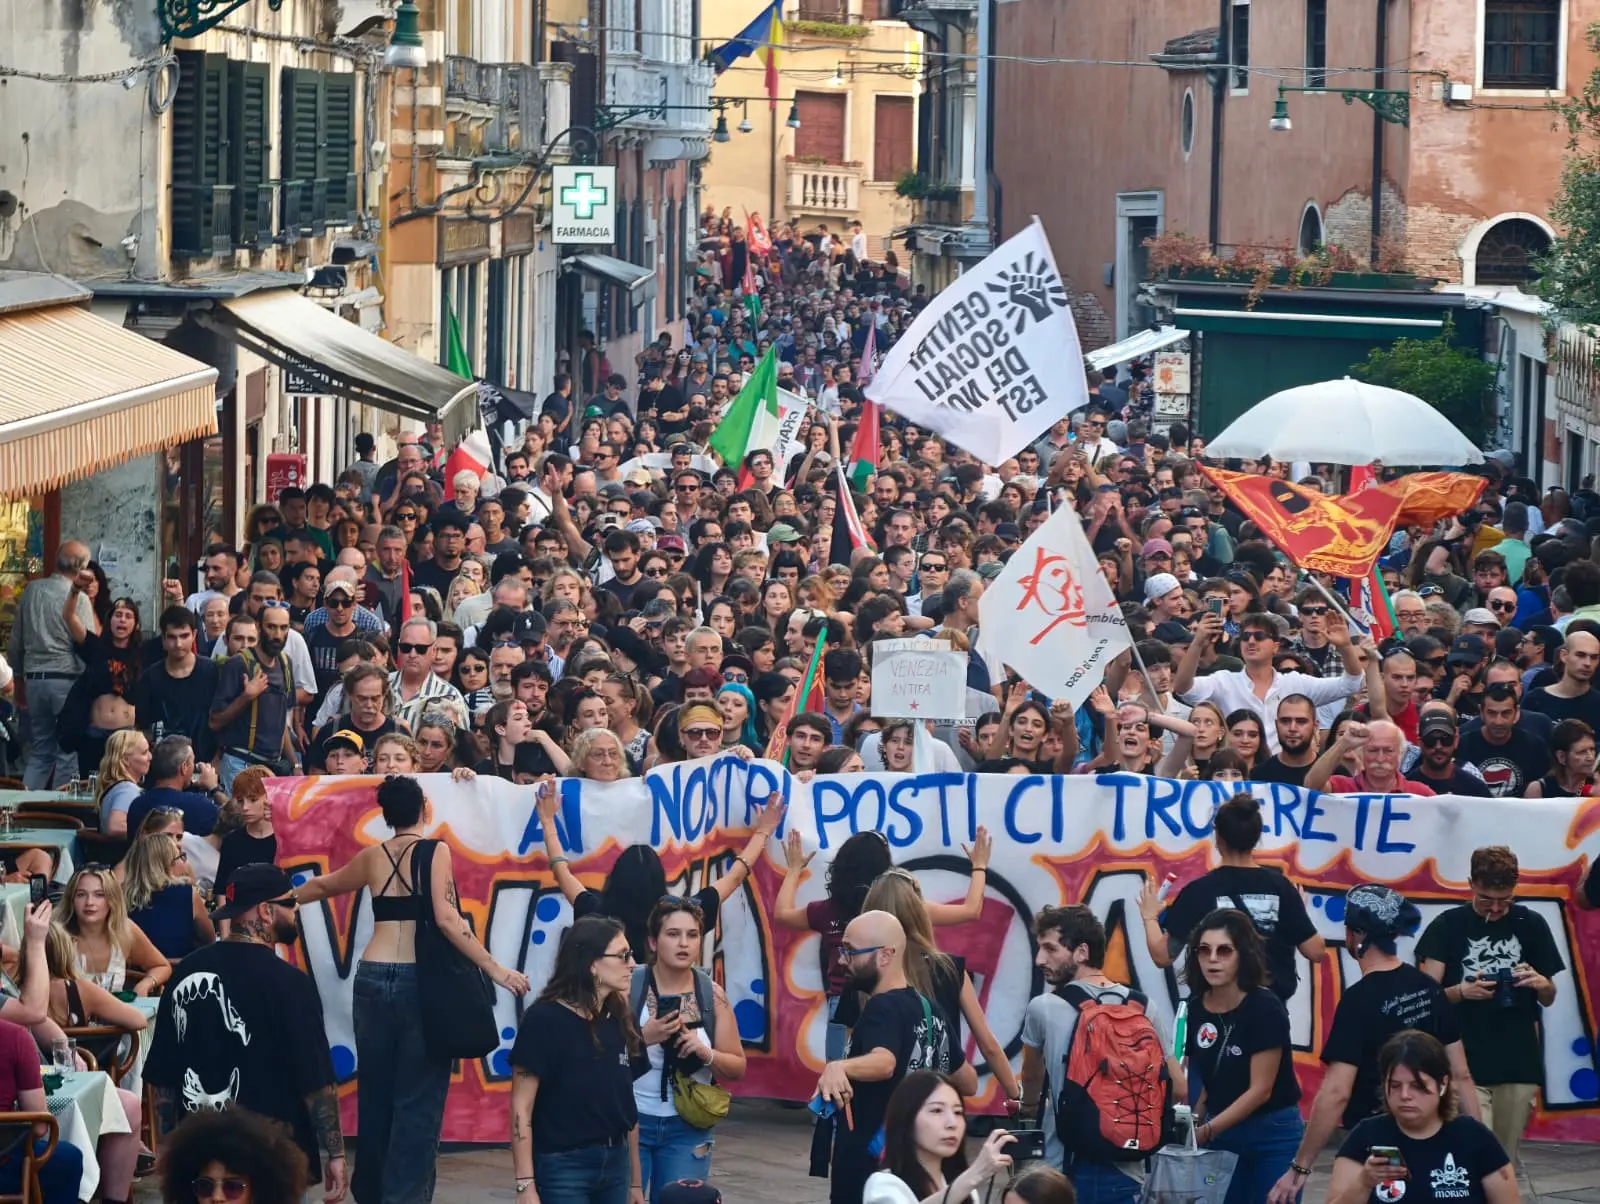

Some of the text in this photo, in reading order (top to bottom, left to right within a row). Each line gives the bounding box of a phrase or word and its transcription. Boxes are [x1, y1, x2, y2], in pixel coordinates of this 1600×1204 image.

[556, 227, 610, 237] FARMACIA
[890, 659, 948, 677] VENEZIA
[890, 683, 931, 696] ANTIFA
[518, 779, 583, 855] AI
[646, 755, 793, 846] NOSTRI
[813, 772, 978, 849] POSTI
[1004, 774, 1064, 844] CI
